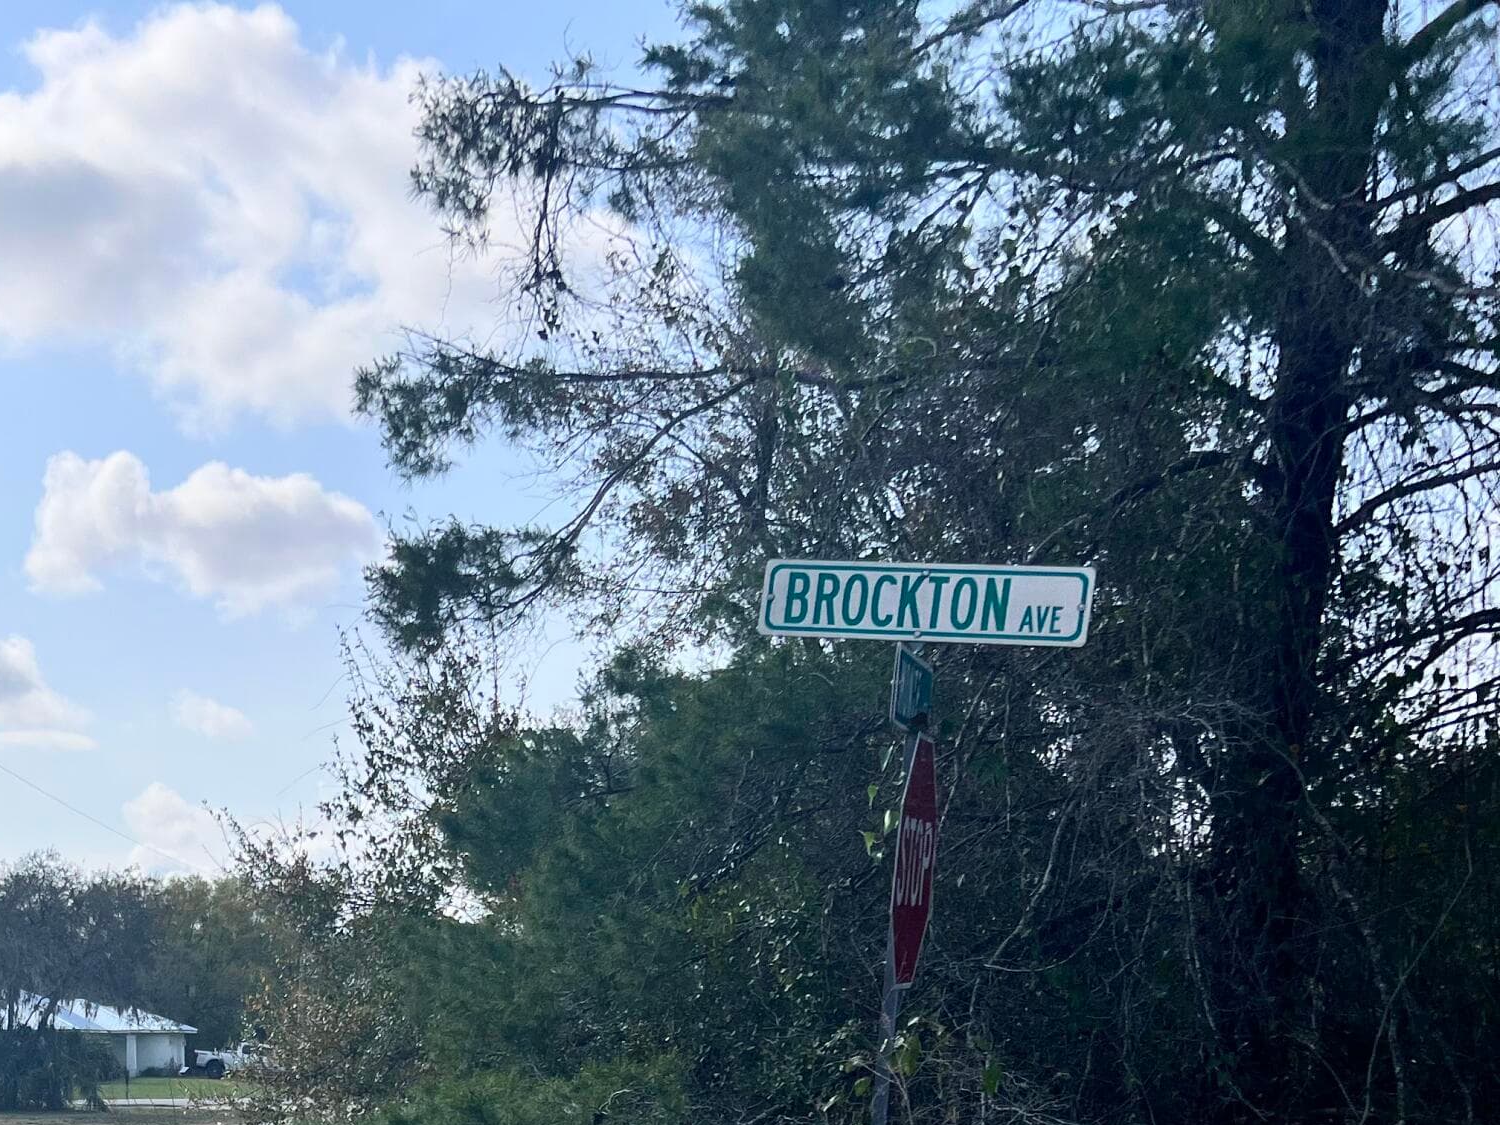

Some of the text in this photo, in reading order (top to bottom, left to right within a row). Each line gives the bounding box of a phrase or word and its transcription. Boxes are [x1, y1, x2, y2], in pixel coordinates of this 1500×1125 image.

[783, 571, 1063, 634] BROCKTON AVE
[896, 815, 934, 907] STOP
